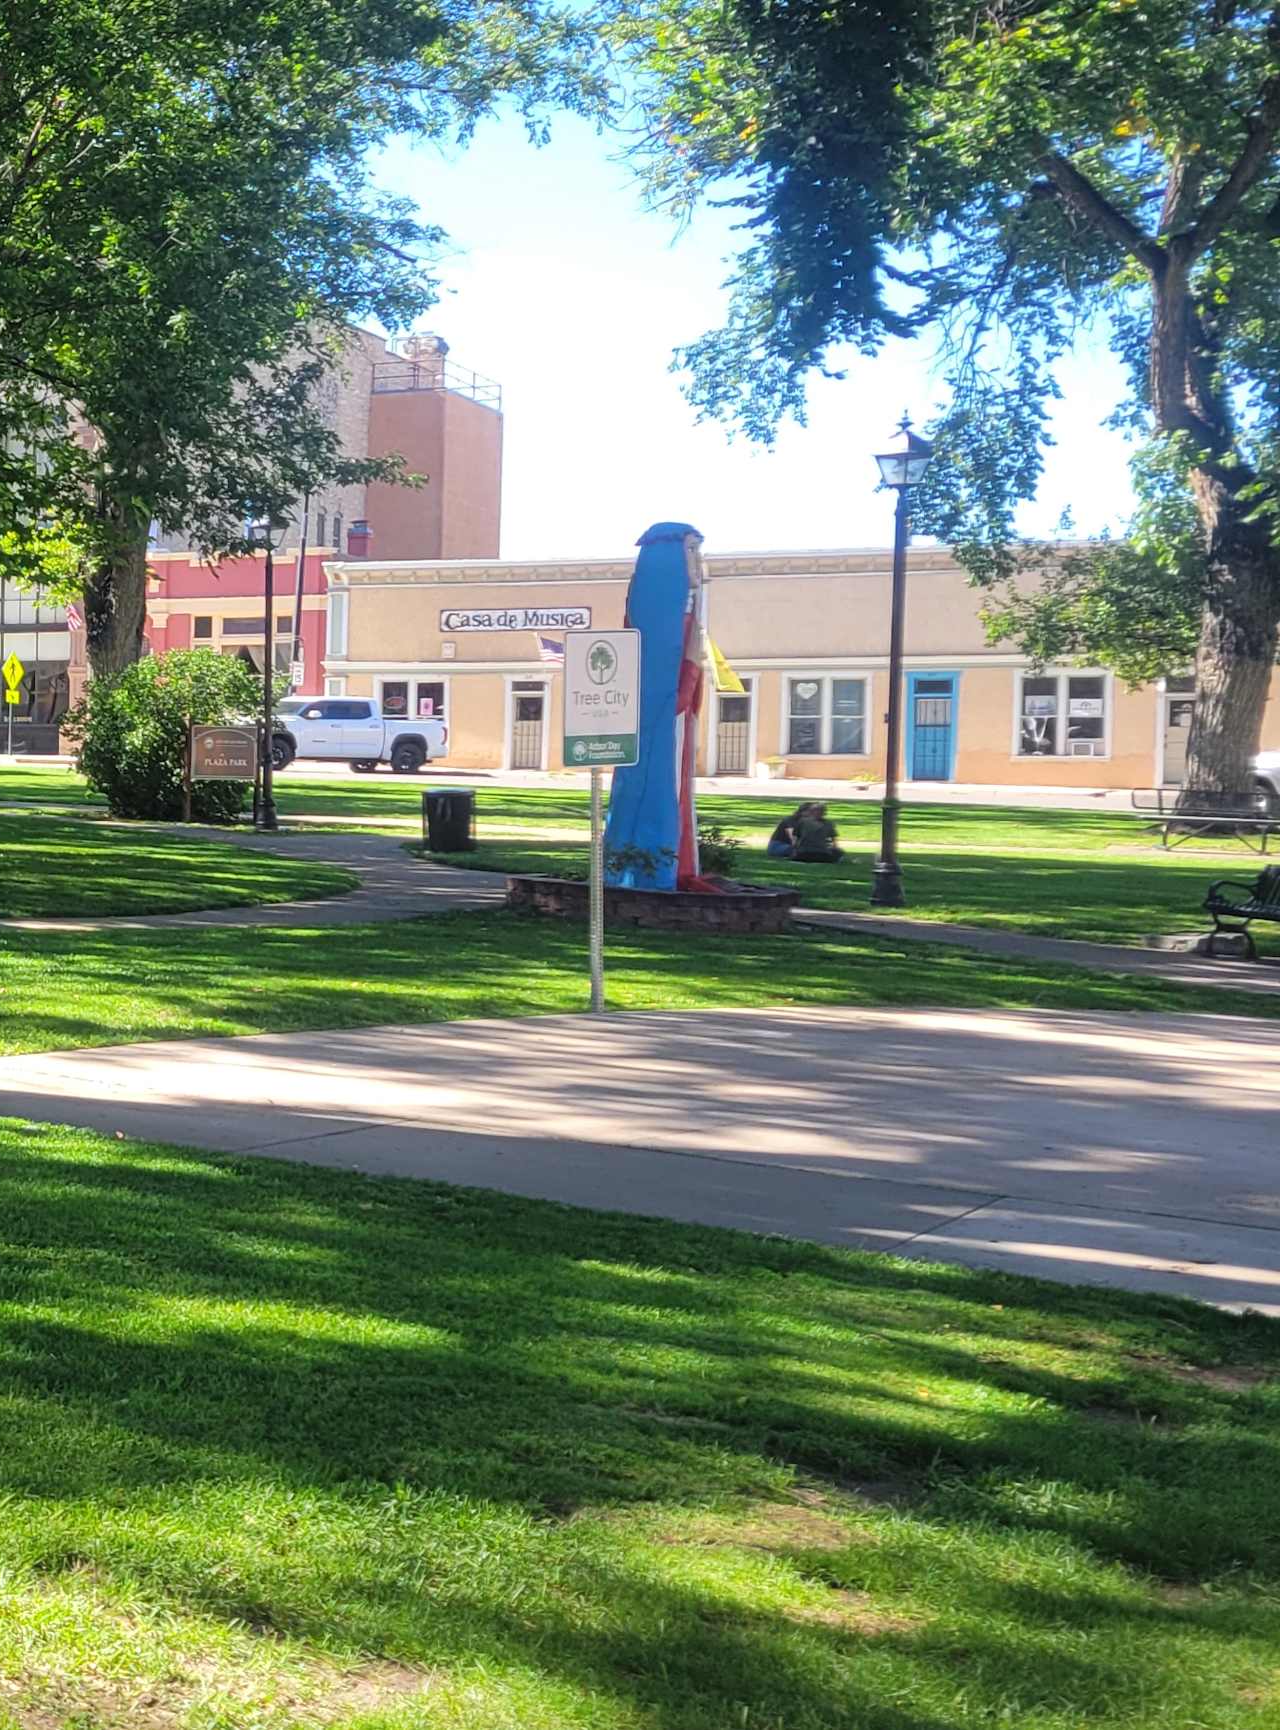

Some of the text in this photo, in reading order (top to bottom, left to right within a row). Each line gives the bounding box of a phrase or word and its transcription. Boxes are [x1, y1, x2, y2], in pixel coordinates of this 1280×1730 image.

[445, 611, 586, 629] Casa de Musica
[572, 690, 629, 707] Tree City
[607, 741, 622, 751] Day
[204, 758, 248, 766] PLAZA PARK
